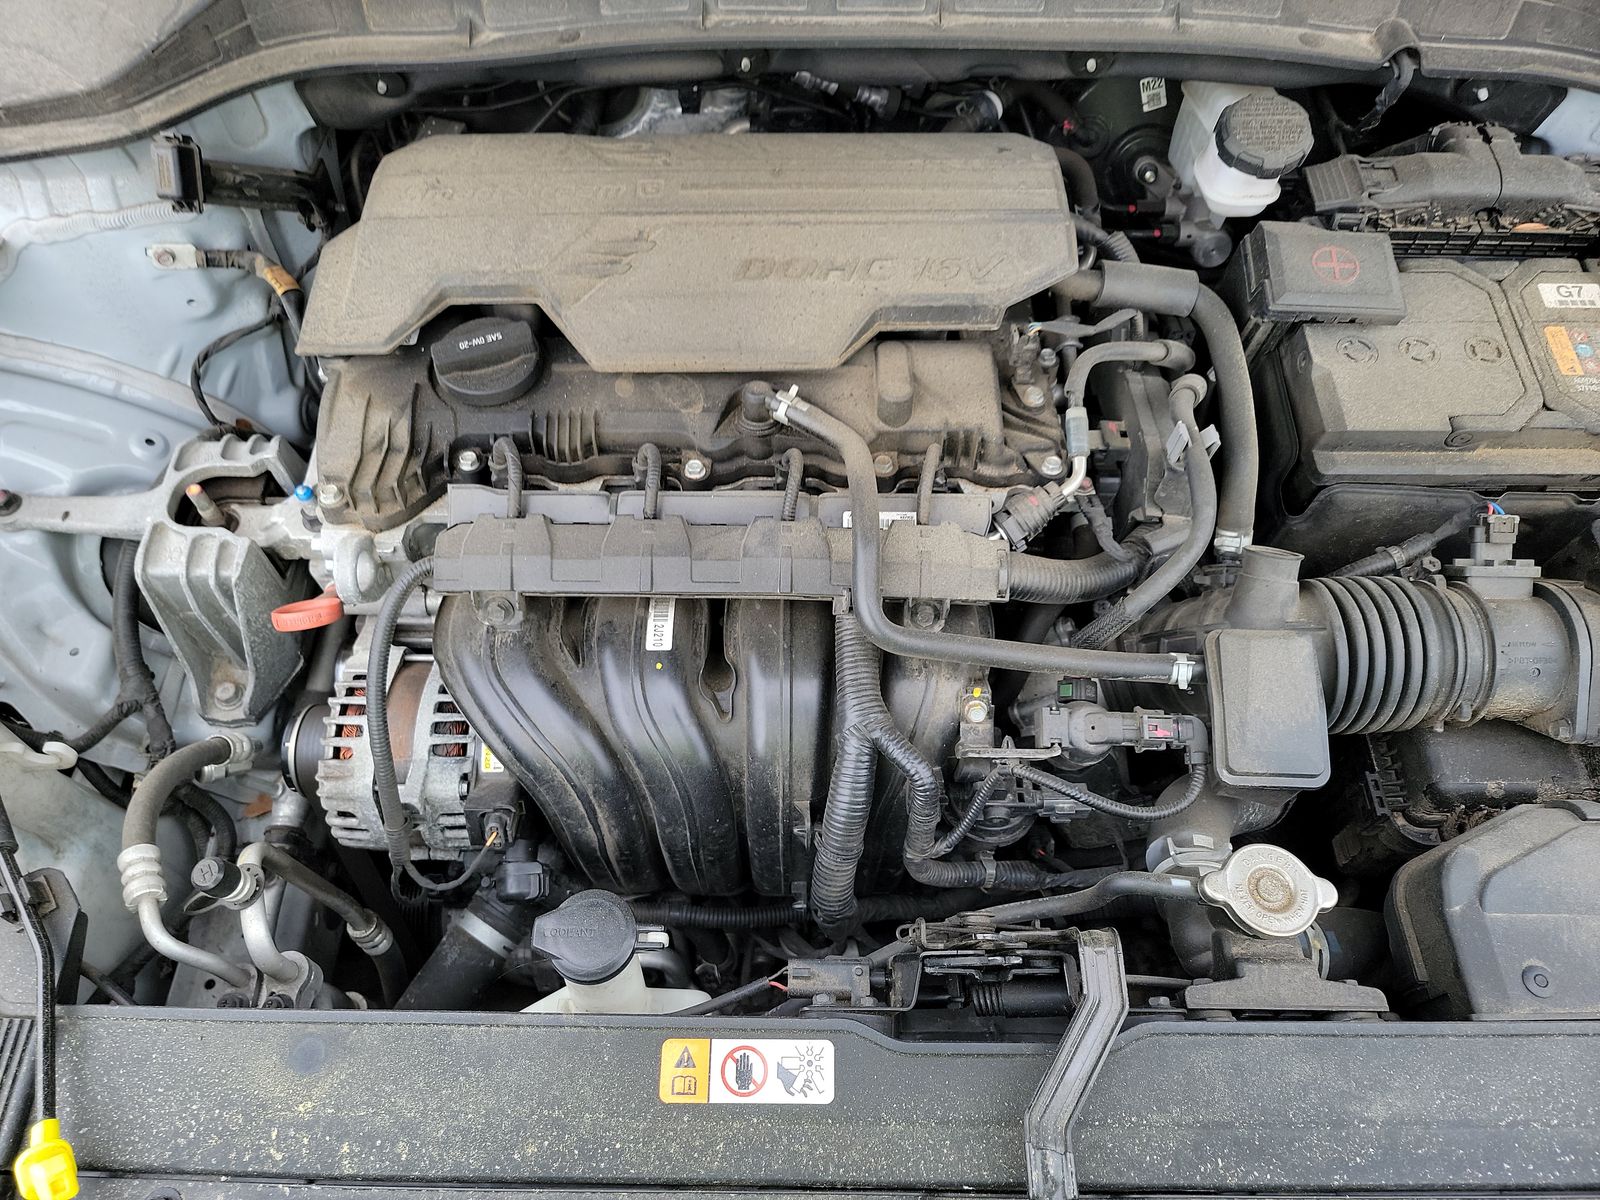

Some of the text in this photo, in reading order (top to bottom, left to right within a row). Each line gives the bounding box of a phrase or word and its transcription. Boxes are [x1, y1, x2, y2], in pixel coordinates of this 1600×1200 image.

[1142, 76, 1163, 93] M22
[733, 254, 1007, 282] DOHC 16V
[1556, 285, 1583, 298] G7
[459, 332, 503, 350] SAE 0W-20
[543, 927, 595, 938] COOLANT
